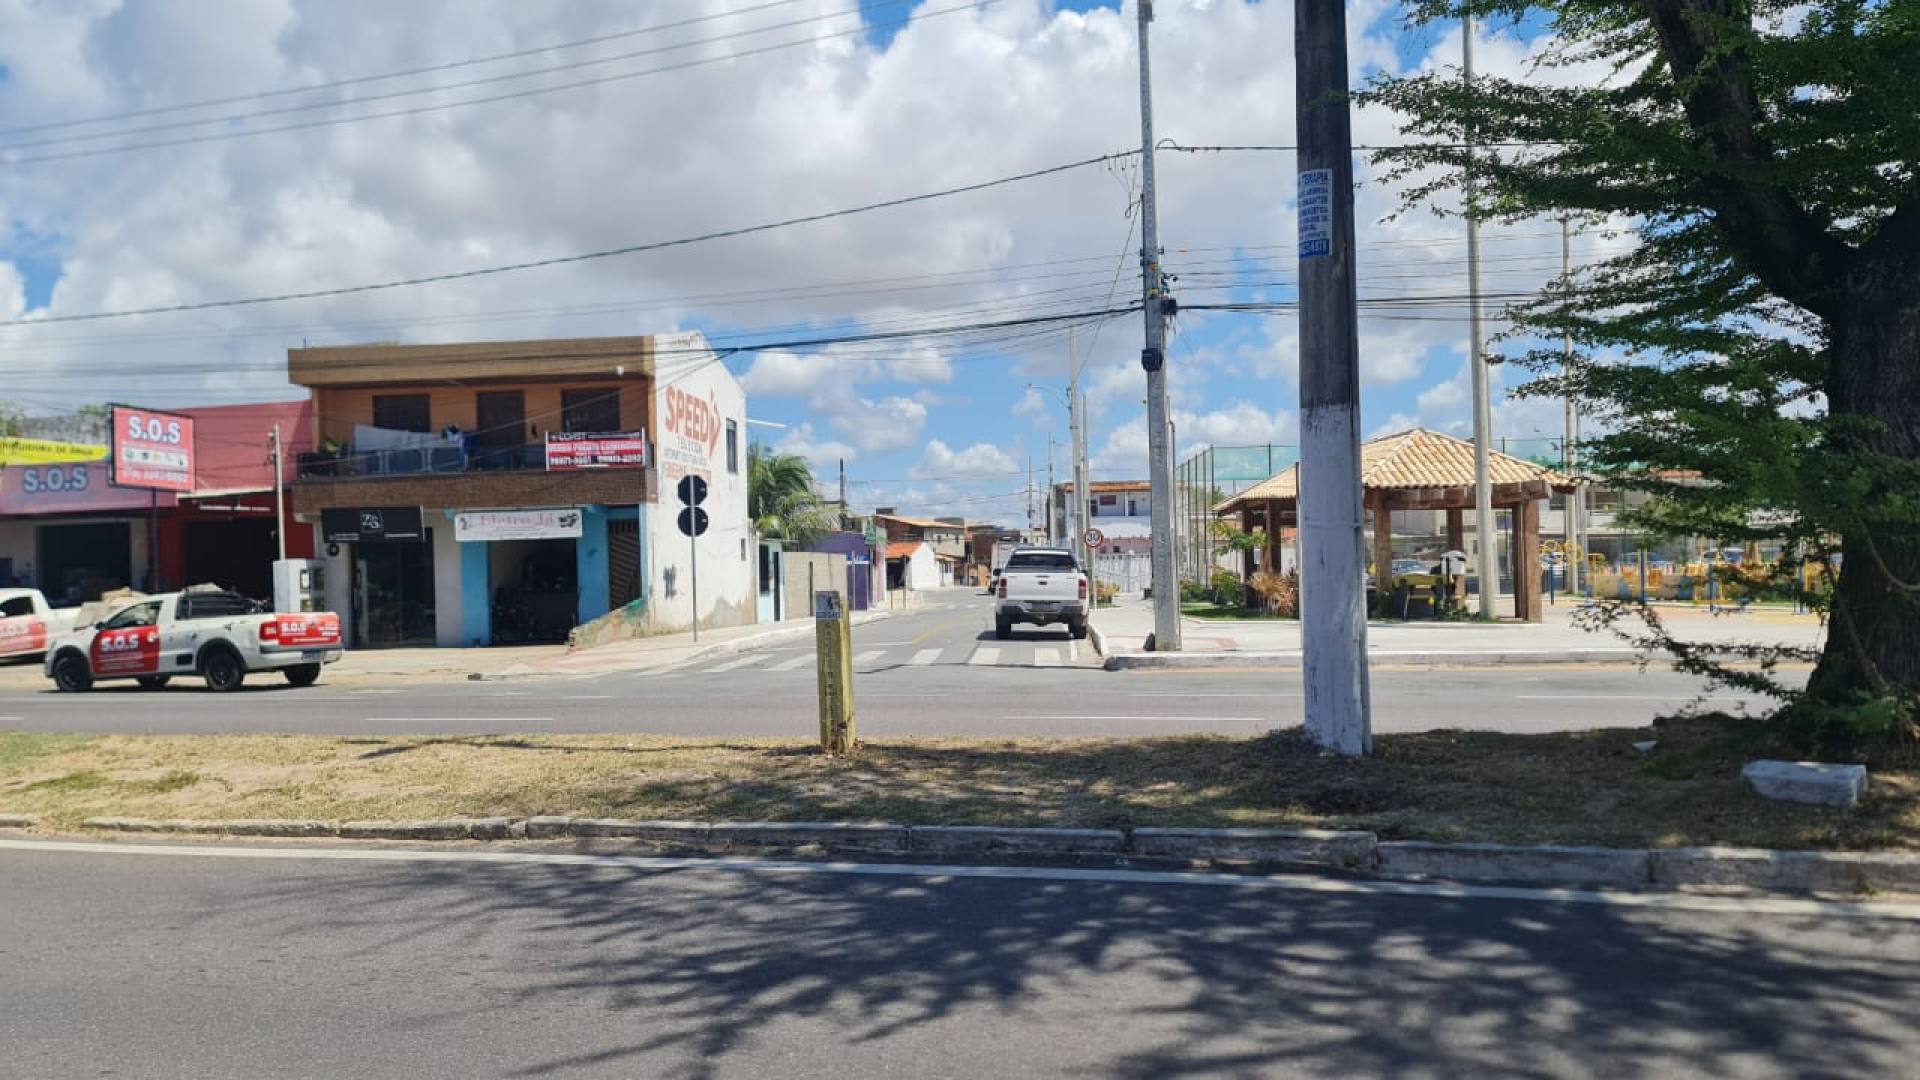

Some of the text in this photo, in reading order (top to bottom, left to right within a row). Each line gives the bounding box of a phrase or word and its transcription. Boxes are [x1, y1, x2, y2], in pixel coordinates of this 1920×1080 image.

[129, 416, 180, 444] S.O.S
[23, 466, 88, 493] S.O.S
[101, 634, 139, 652] S.O.S
